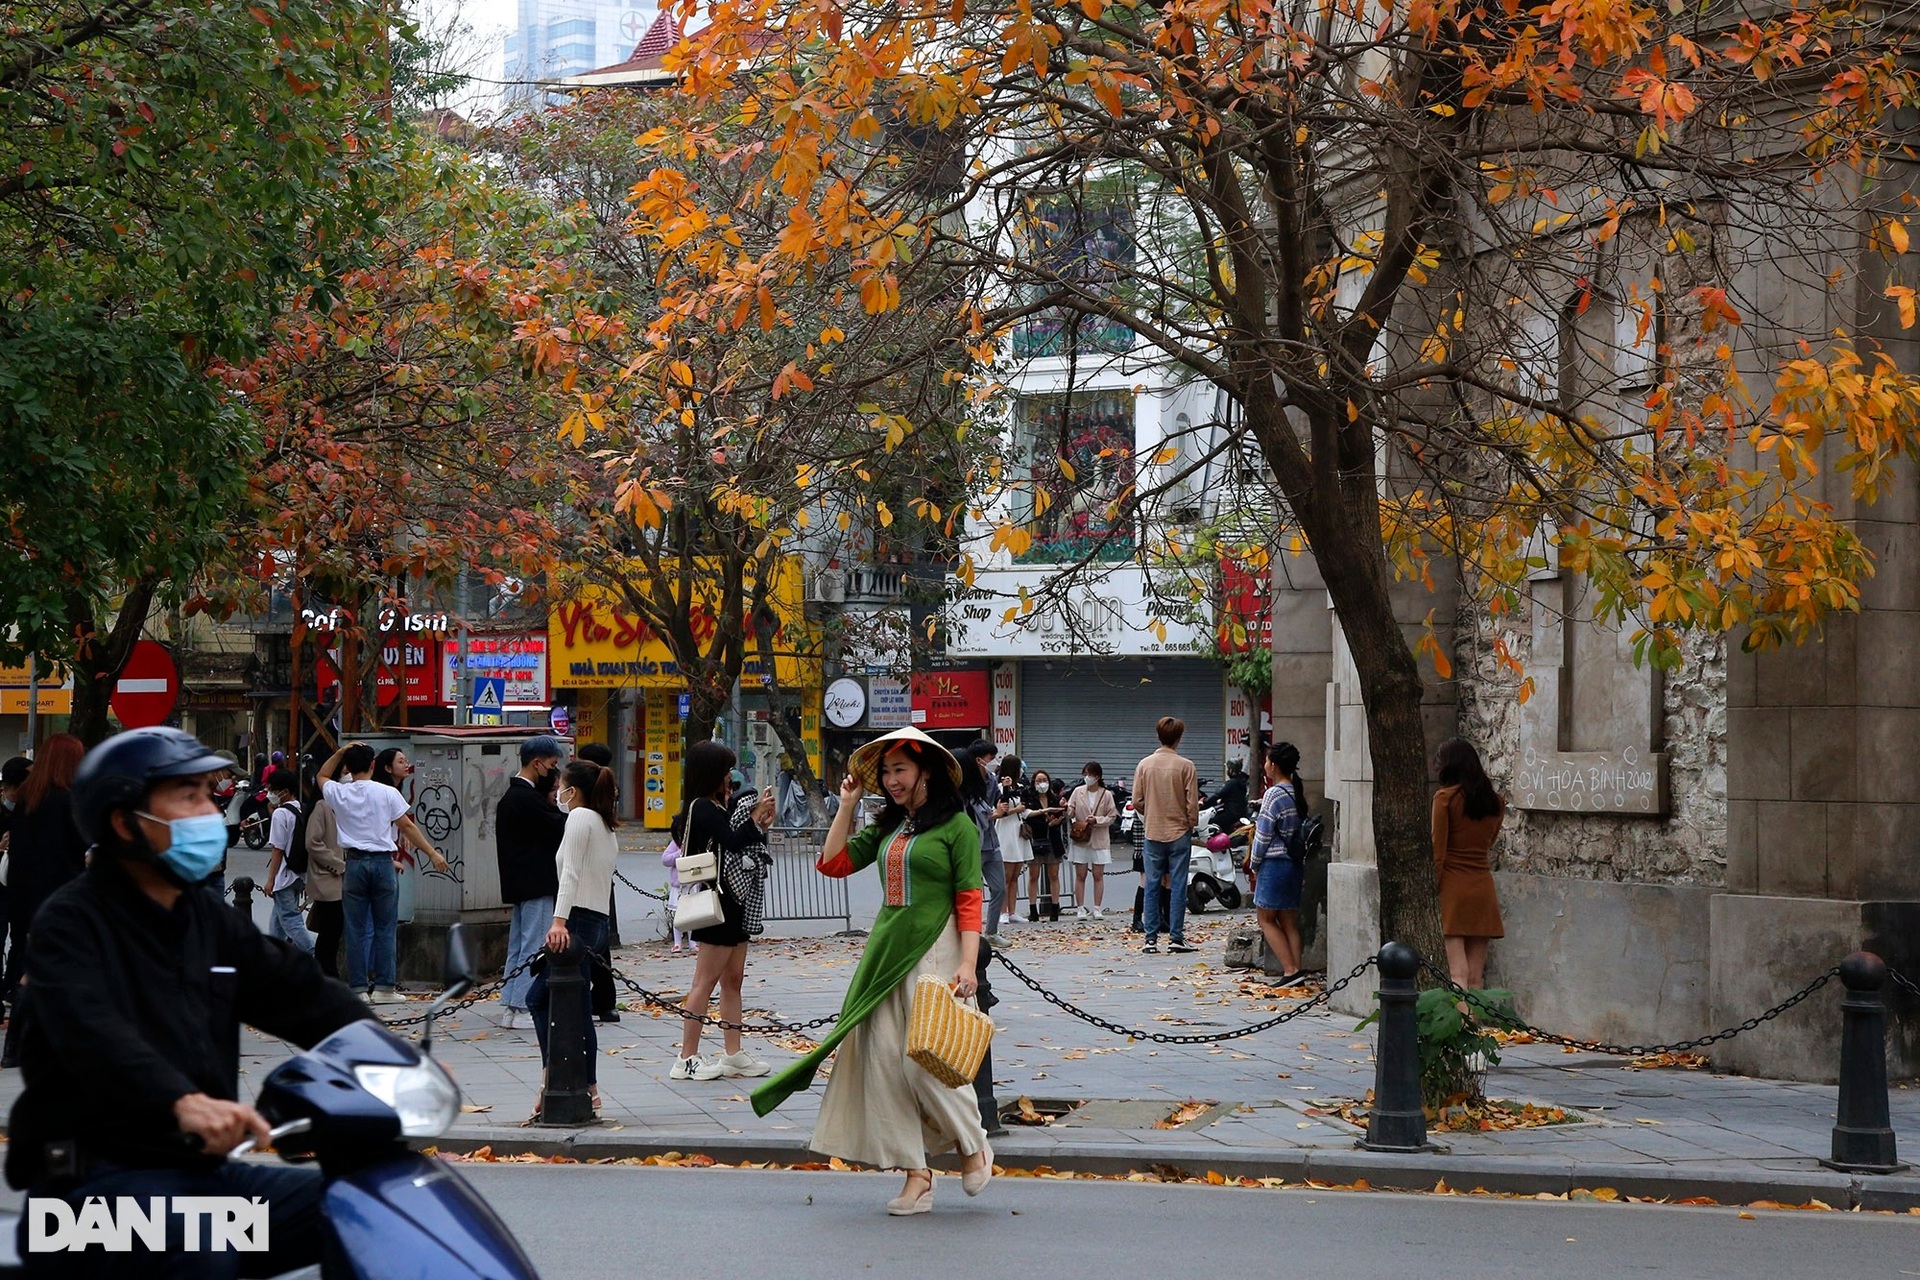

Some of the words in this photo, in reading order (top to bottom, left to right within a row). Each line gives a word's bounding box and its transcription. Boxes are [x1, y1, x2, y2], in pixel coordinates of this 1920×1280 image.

[962, 604, 991, 622] Shop
[570, 657, 596, 675] NHÀ
[936, 675, 960, 696] Me
[995, 668, 1013, 689] CƯỚI
[998, 694, 1011, 716] HỎI
[1230, 694, 1245, 717] HỎI
[995, 728, 1015, 748] TRỌN
[1627, 770, 1653, 790] 2002
